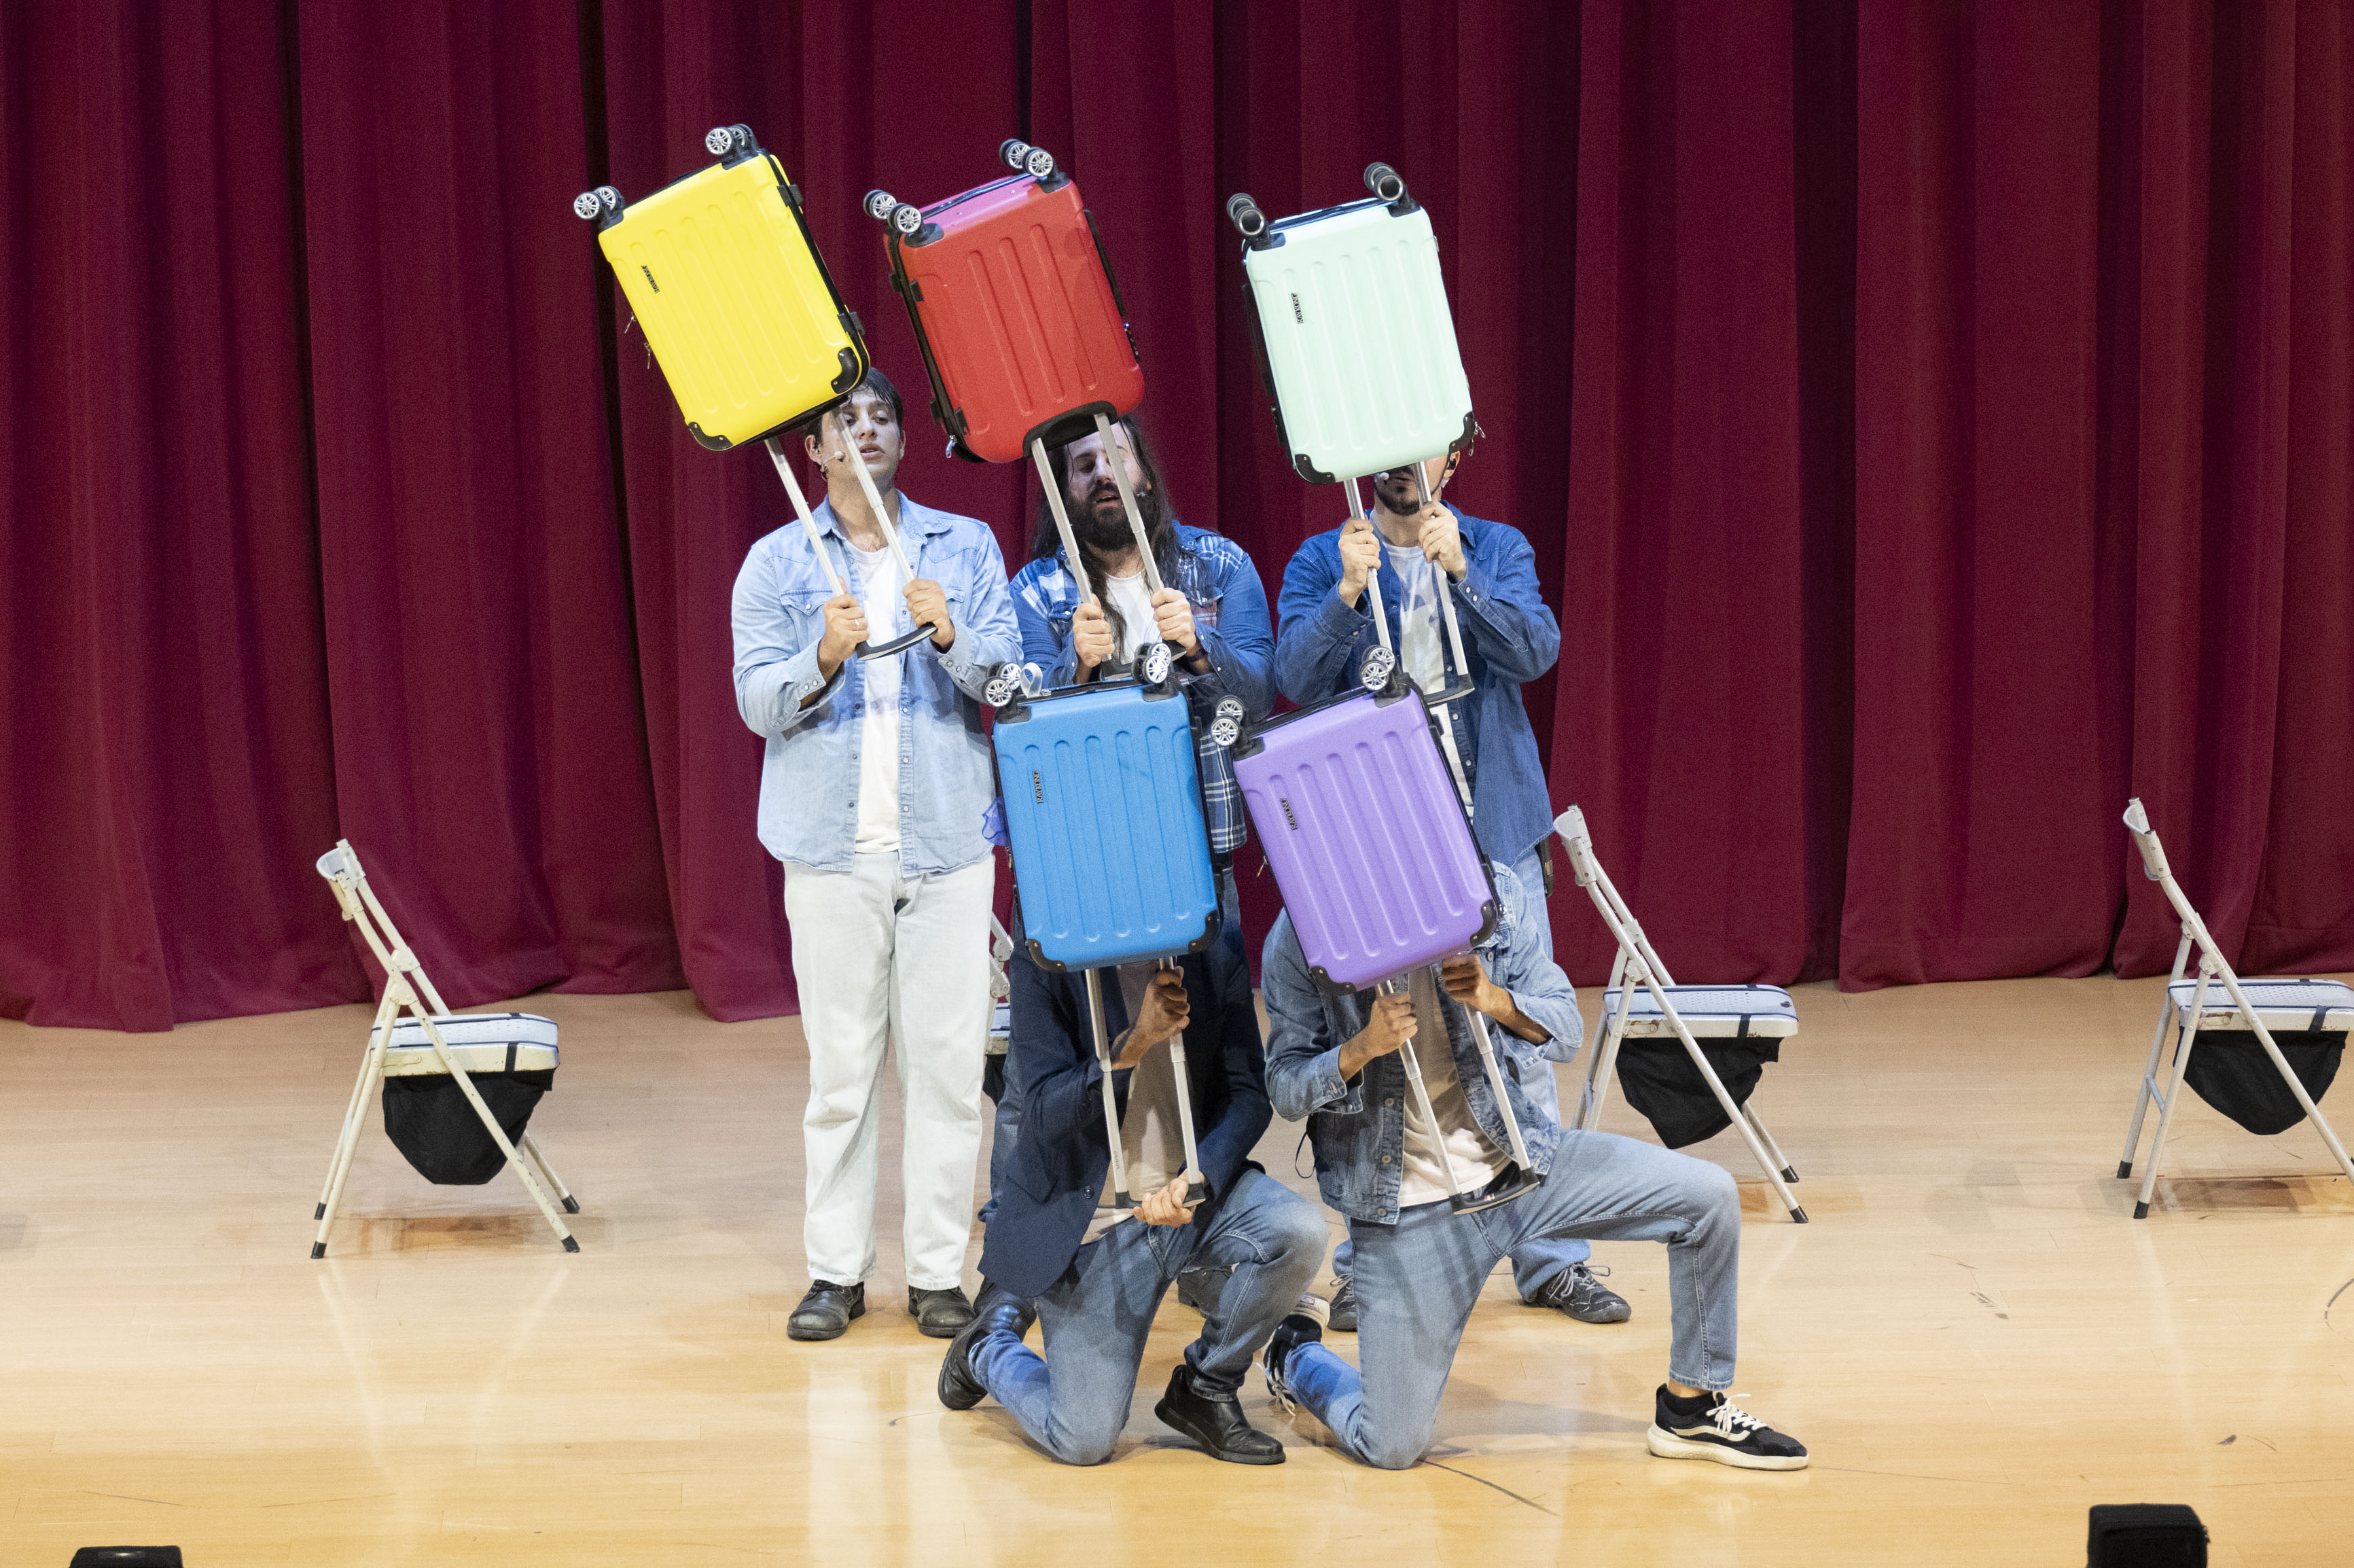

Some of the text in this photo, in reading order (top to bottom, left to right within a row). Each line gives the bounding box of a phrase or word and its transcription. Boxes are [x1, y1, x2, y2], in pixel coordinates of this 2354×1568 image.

[1291, 293, 1304, 324] RAYKONG
[1033, 770, 1044, 804] RAYKONG
[1280, 798, 1298, 831] RAYKONG
